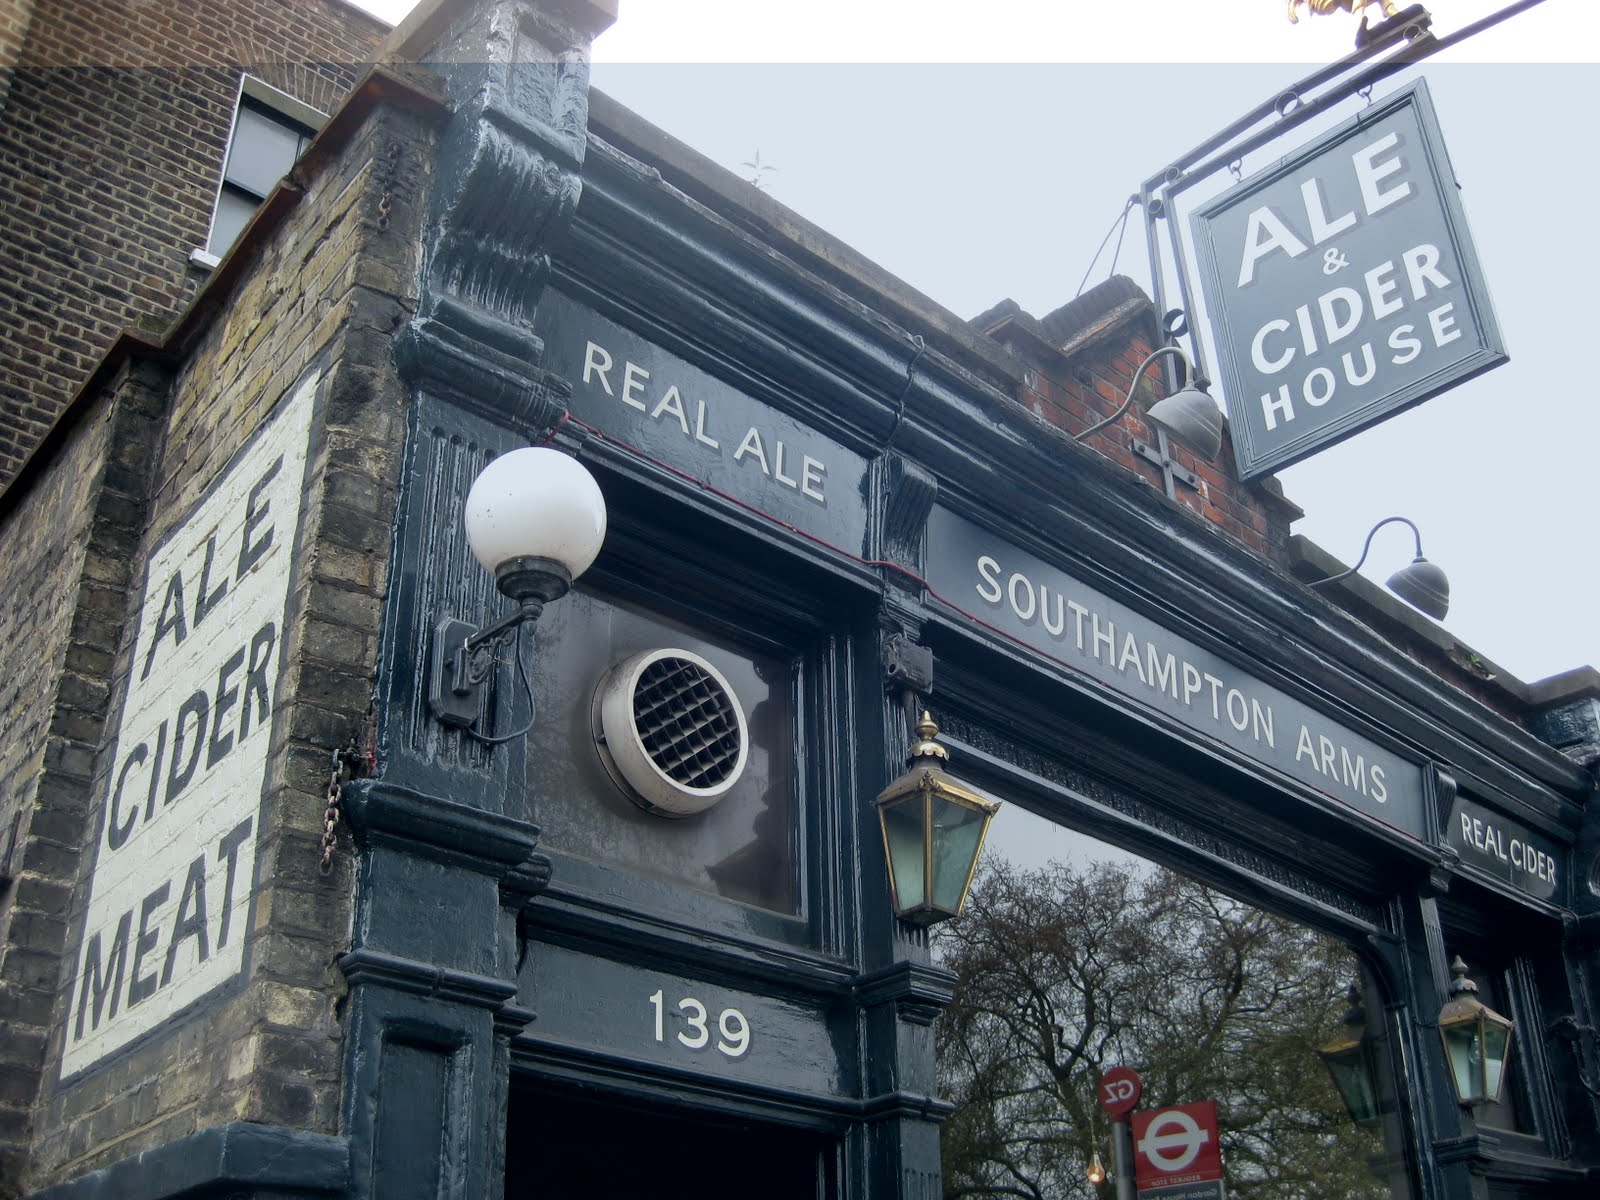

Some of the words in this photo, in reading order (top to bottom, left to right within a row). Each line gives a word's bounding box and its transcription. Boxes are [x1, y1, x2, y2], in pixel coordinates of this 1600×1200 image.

[1237, 131, 1412, 289] ALE
[1321, 247, 1351, 275] &
[1250, 243, 1453, 375] CIDER
[1260, 301, 1463, 432] HOUSE
[582, 340, 719, 450] REAL
[732, 426, 826, 503] ALE
[141, 453, 285, 682] ALE
[108, 621, 276, 851] CIDER
[975, 555, 1275, 749] SOUTHAMPTON
[1294, 724, 1388, 804] ARMS
[1460, 811, 1508, 861] REAL
[1509, 838, 1556, 886] CIDER
[73, 814, 253, 1043] MEAT
[649, 989, 751, 1057] 139
